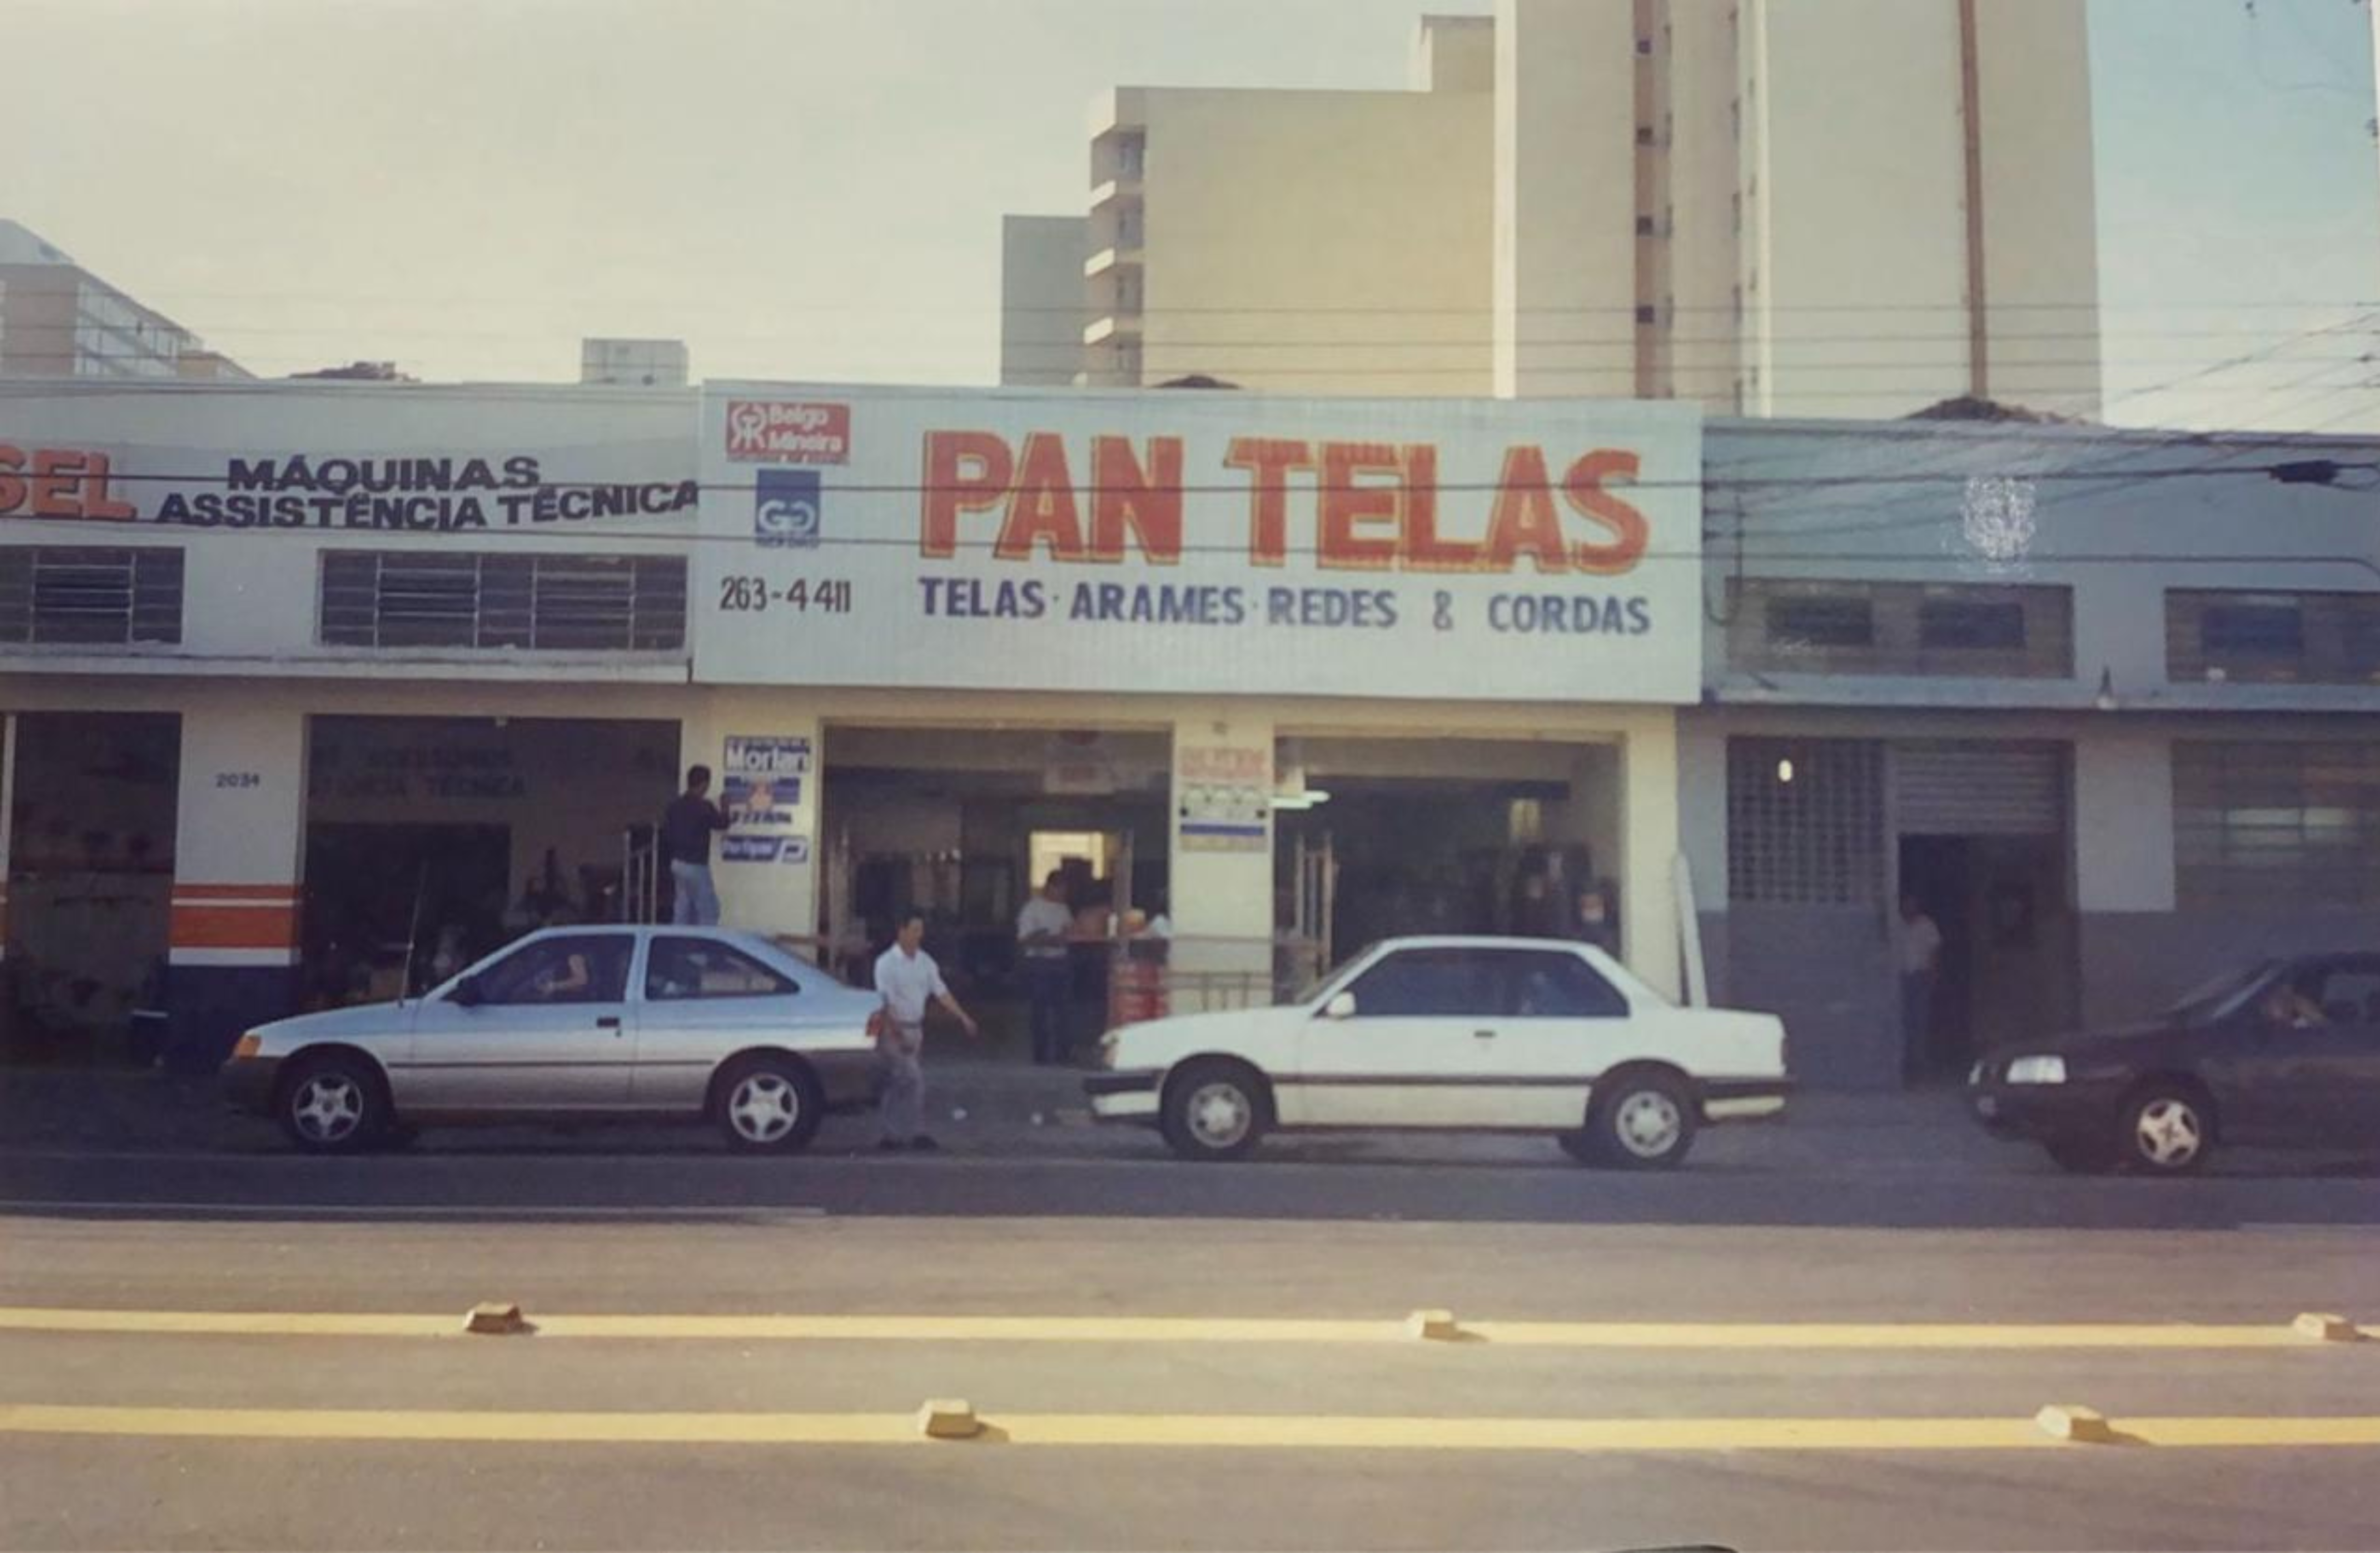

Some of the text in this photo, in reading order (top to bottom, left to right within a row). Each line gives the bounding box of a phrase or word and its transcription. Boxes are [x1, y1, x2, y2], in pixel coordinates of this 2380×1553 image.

[228, 454, 540, 495] MÁQUINAS
[155, 480, 699, 530] ASSISTÊNCIA TÉCNICA
[920, 430, 1650, 576] PAN TELAS
[918, 577, 1651, 635] TELAS ARAMES REDES & CORDAS
[215, 772, 261, 788] 2034
